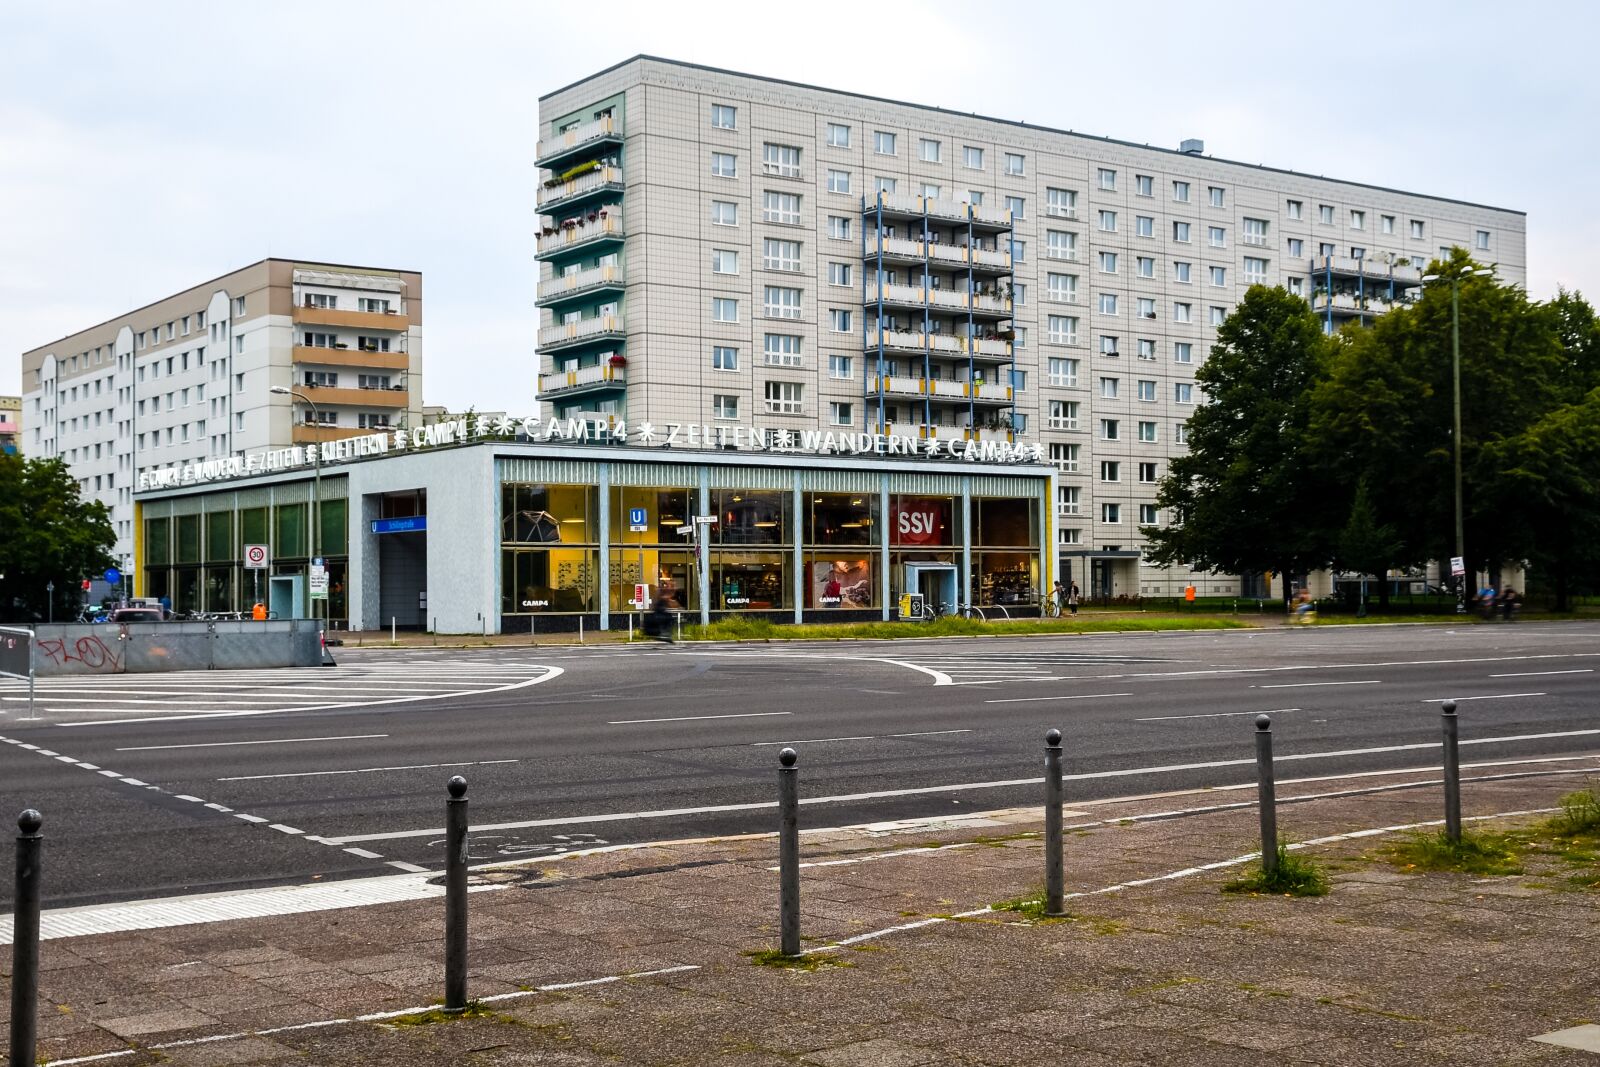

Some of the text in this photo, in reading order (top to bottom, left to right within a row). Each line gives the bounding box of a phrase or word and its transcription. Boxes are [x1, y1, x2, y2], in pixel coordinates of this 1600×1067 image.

[194, 456, 241, 480] WANDERN
[260, 446, 302, 470] ZELTEN
[321, 433, 388, 461] KLETTERN
[412, 419, 467, 448] CAMP4
[523, 416, 1025, 461] CAMP4 ZELTEN WANDERN CAMP4
[632, 511, 642, 523] U
[900, 511, 934, 534] SSV
